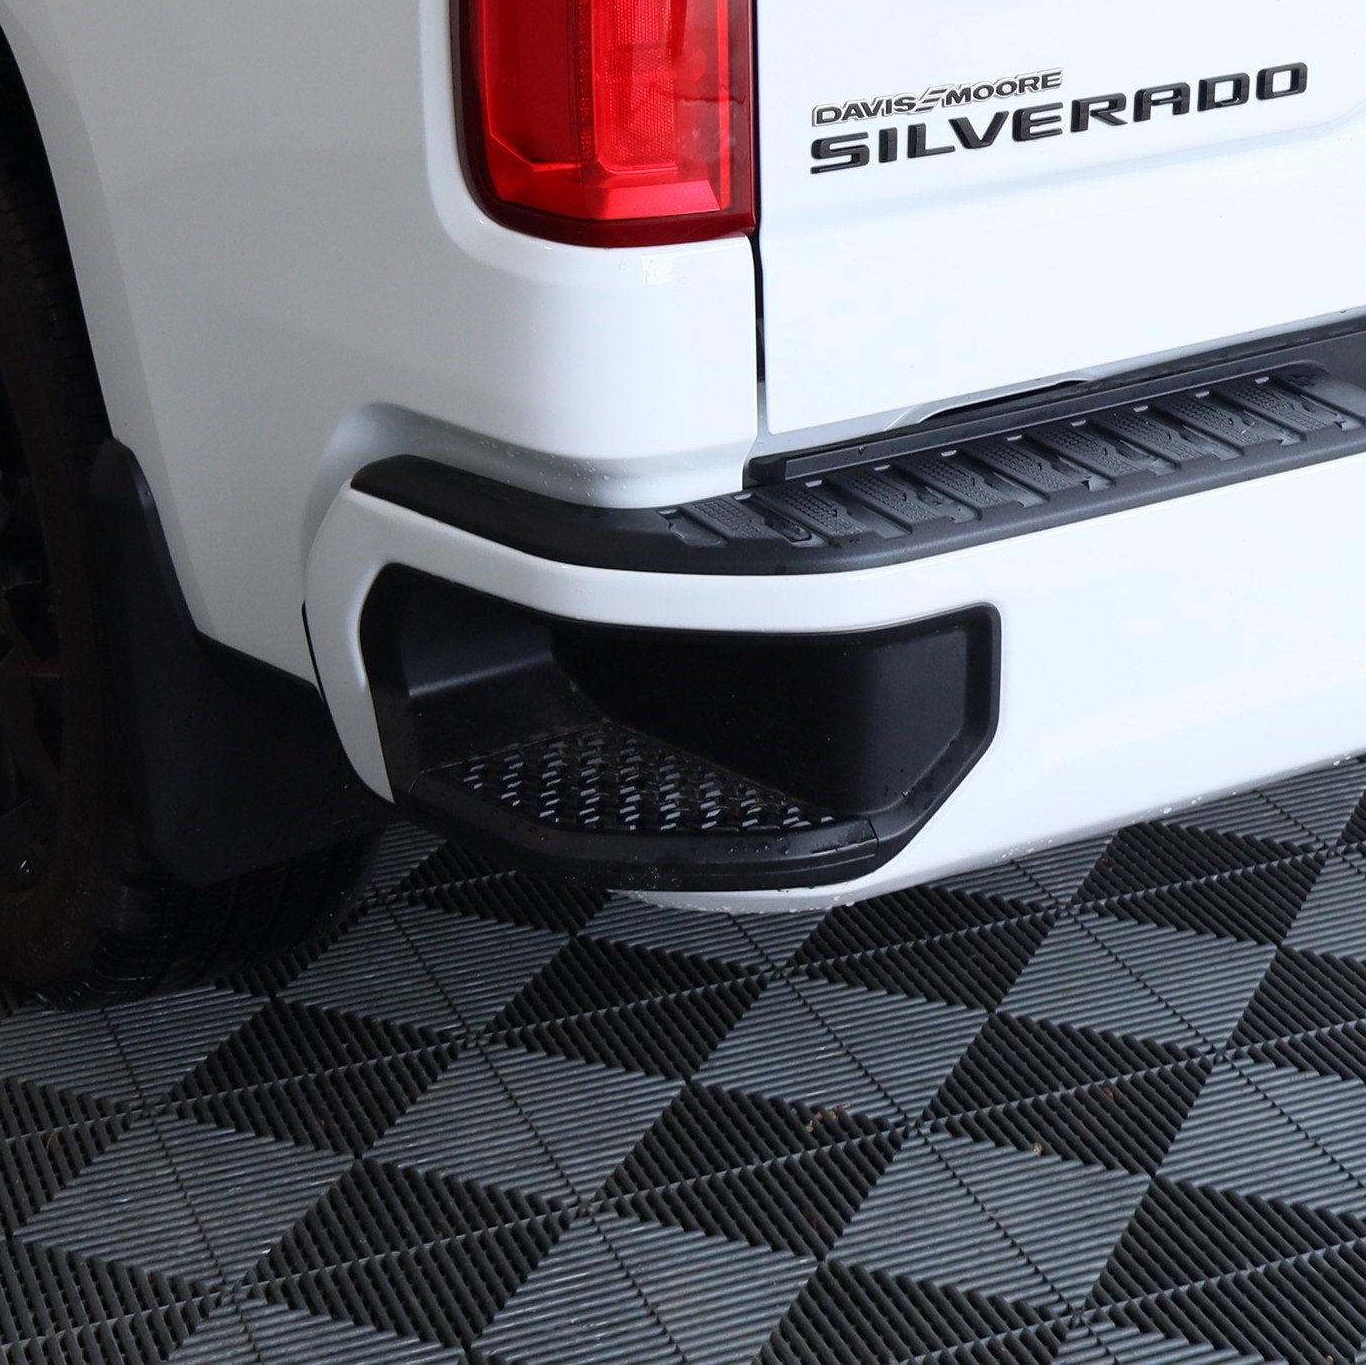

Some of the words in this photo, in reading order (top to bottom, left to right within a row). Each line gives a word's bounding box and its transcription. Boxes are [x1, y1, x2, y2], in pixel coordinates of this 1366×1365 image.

[810, 61, 1309, 175] SILVERADO
[812, 92, 918, 128] DAVIS
[941, 67, 1064, 108] MOORE
